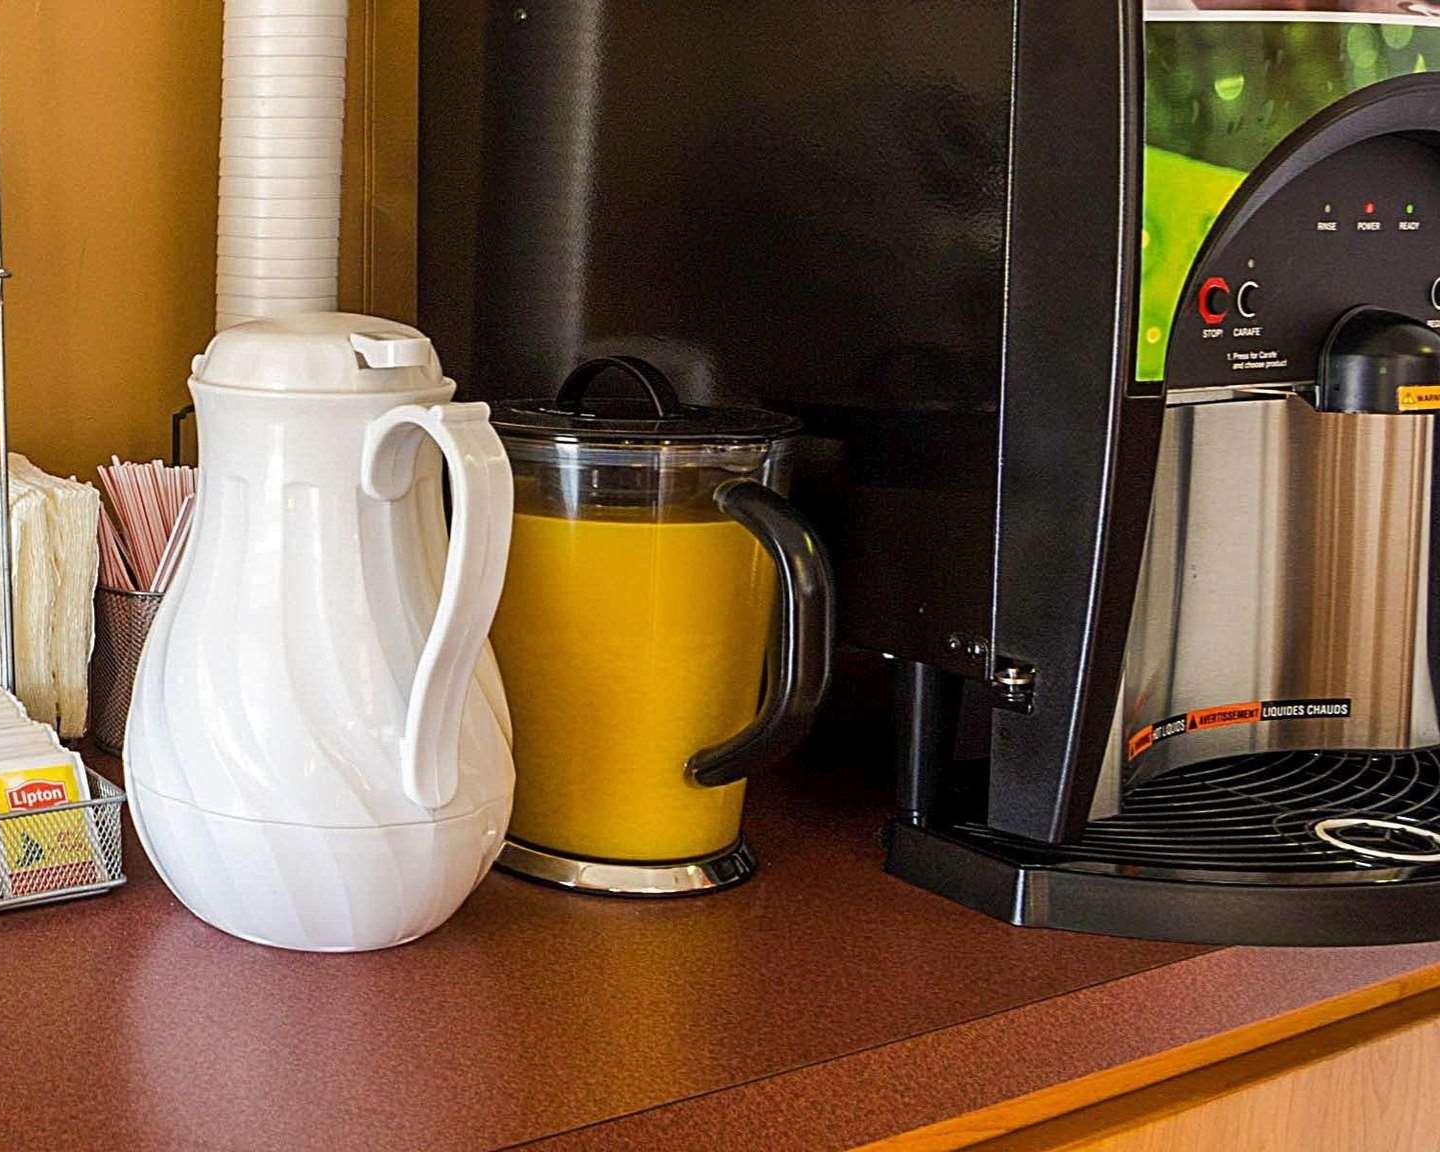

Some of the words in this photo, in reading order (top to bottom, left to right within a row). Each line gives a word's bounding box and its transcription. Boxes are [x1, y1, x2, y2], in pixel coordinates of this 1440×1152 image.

[1357, 221, 1381, 231] POWER
[1398, 221, 1420, 231] READY
[1202, 328, 1224, 339] STOP
[1233, 327, 1262, 337] CARAFE
[1263, 705, 1305, 717] LIQUIDES
[1306, 704, 1348, 715] CHAUDS
[12, 789, 63, 806] Lipton
